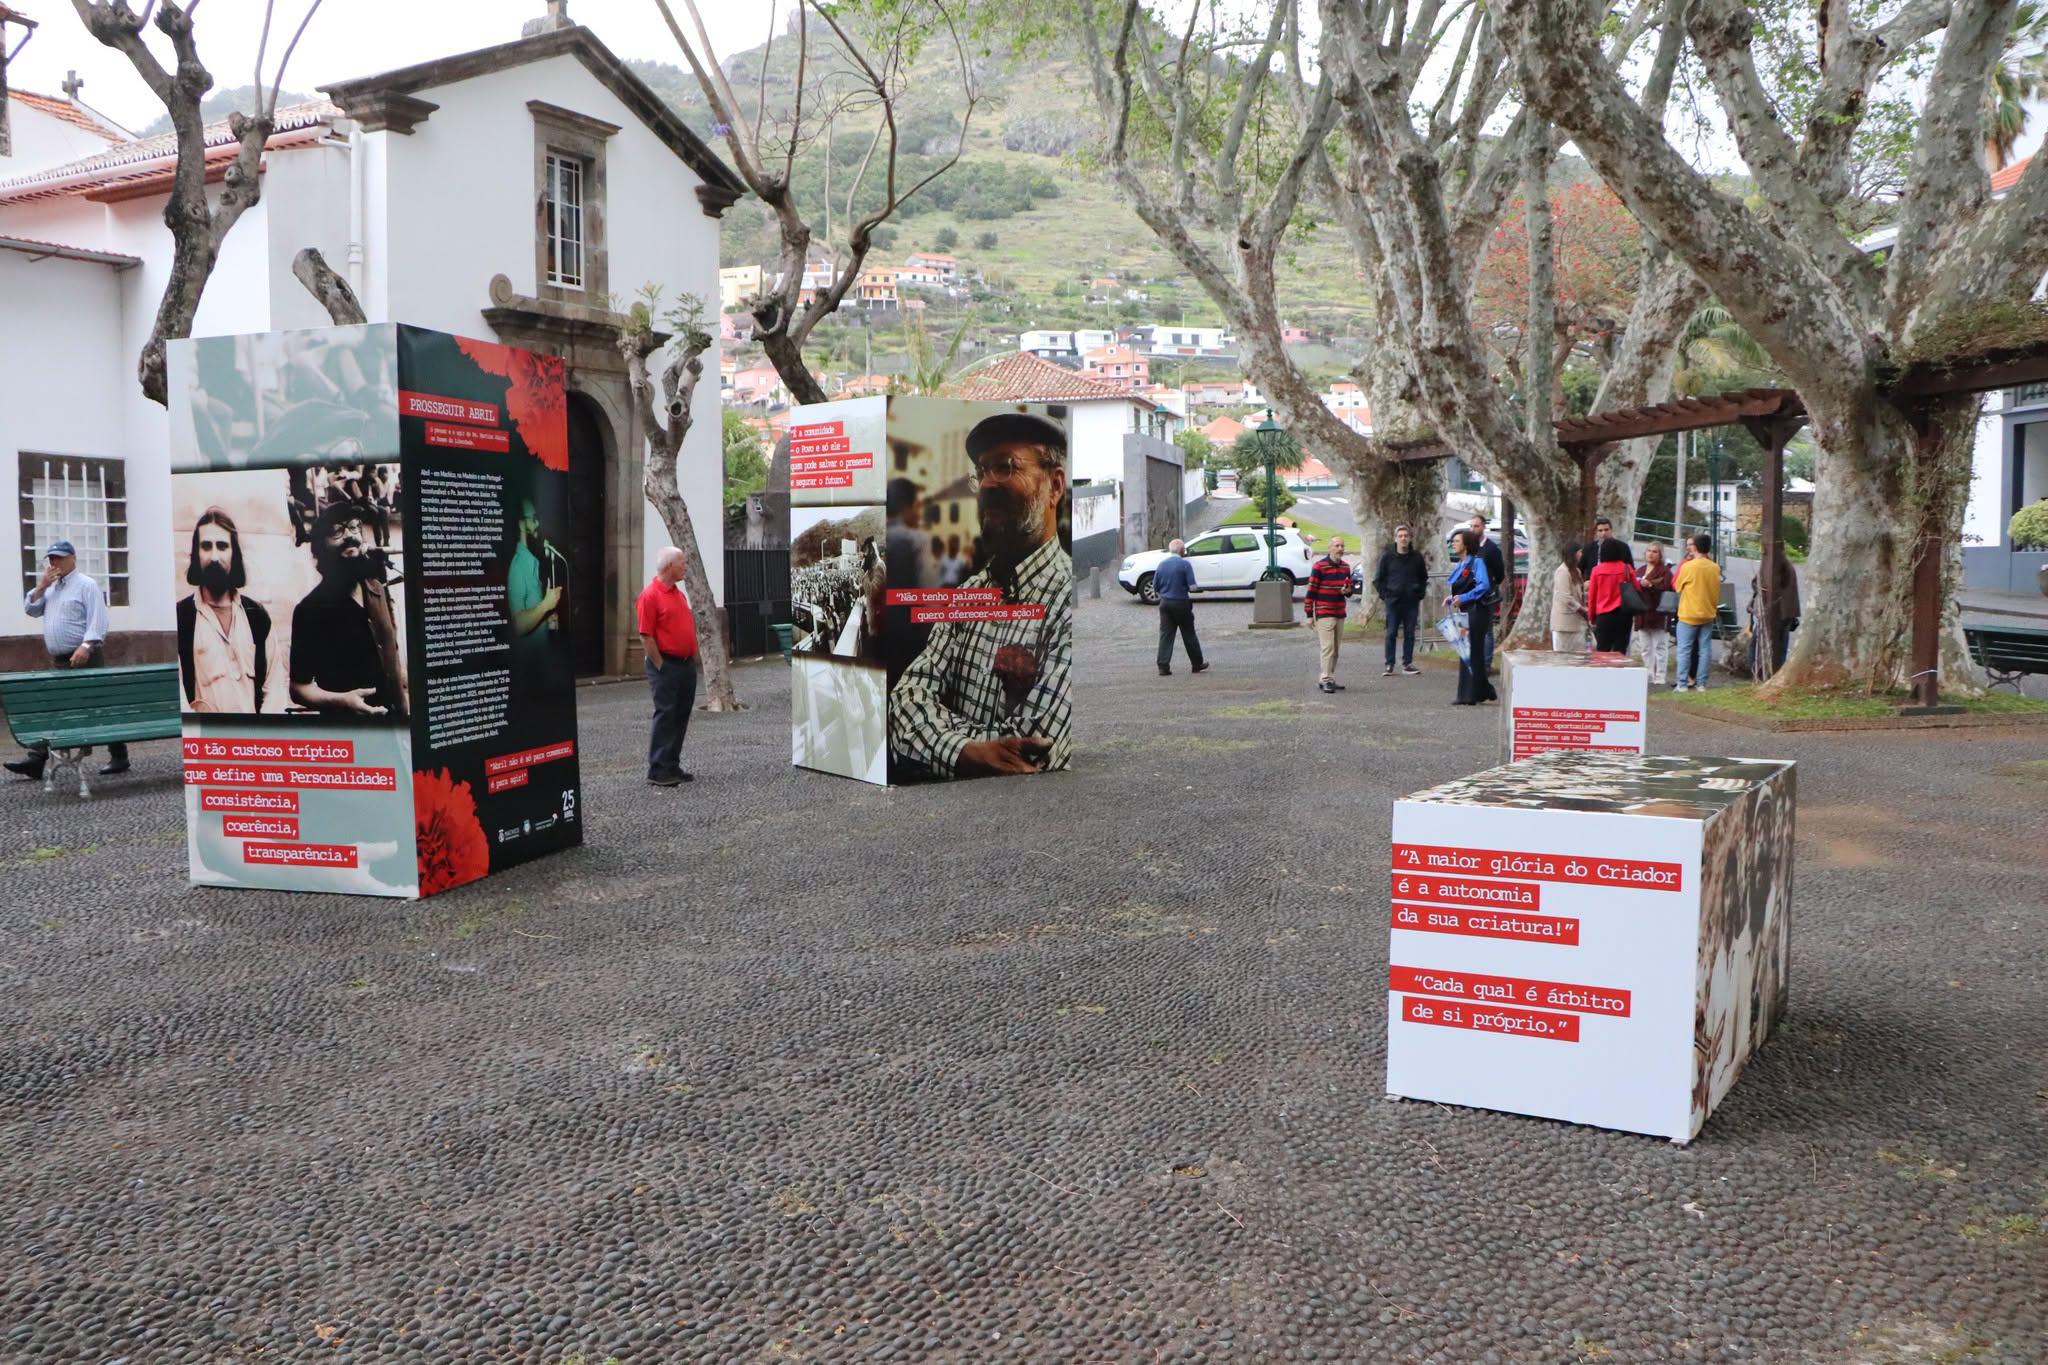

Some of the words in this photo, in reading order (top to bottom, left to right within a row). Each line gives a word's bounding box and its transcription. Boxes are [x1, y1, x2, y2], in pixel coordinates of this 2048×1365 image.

[409, 398, 464, 416] PROSSEGUIR
[469, 407, 495, 421] ABRIL
[804, 461, 817, 472] pode
[819, 460, 837, 468] salvar
[896, 592, 917, 601] “Não
[922, 592, 948, 601] tenho
[952, 592, 996, 604] palavras,
[917, 610, 944, 621] quero
[949, 608, 1008, 618] oferecer-vos
[1012, 608, 1040, 619] ação!”
[184, 743, 198, 754] “O
[205, 742, 226, 755] tão
[232, 744, 282, 757] custoso
[289, 744, 348, 760] tríptico
[533, 753, 544, 762] para
[185, 769, 207, 782] que
[213, 768, 255, 782] define
[262, 773, 284, 782] uma
[290, 771, 394, 785] Personalidade:
[496, 779, 508, 789] para
[206, 793, 297, 810] consistência,
[562, 790, 574, 811] 25
[226, 819, 297, 836] coerência,
[248, 845, 356, 863] transparência.”
[1400, 849, 1420, 864] “A
[1428, 852, 1480, 869] maior
[1491, 856, 1555, 875] glória
[1565, 861, 1588, 878] do
[1598, 864, 1677, 884] Criador
[1398, 879, 1409, 893] é
[1419, 884, 1429, 894] a
[1439, 884, 1532, 903] autonomia
[1398, 908, 1418, 924] da
[1428, 914, 1459, 926] sua
[1469, 916, 1574, 937] criatura!”
[1414, 974, 1464, 994] “Cada
[1474, 979, 1515, 1000] qual
[1526, 986, 1537, 1001] é
[1547, 989, 1624, 1012] árbitro
[1412, 1003, 1433, 1019] de
[1443, 1007, 1463, 1023] si
[1473, 1011, 1567, 1034] próprio.”
